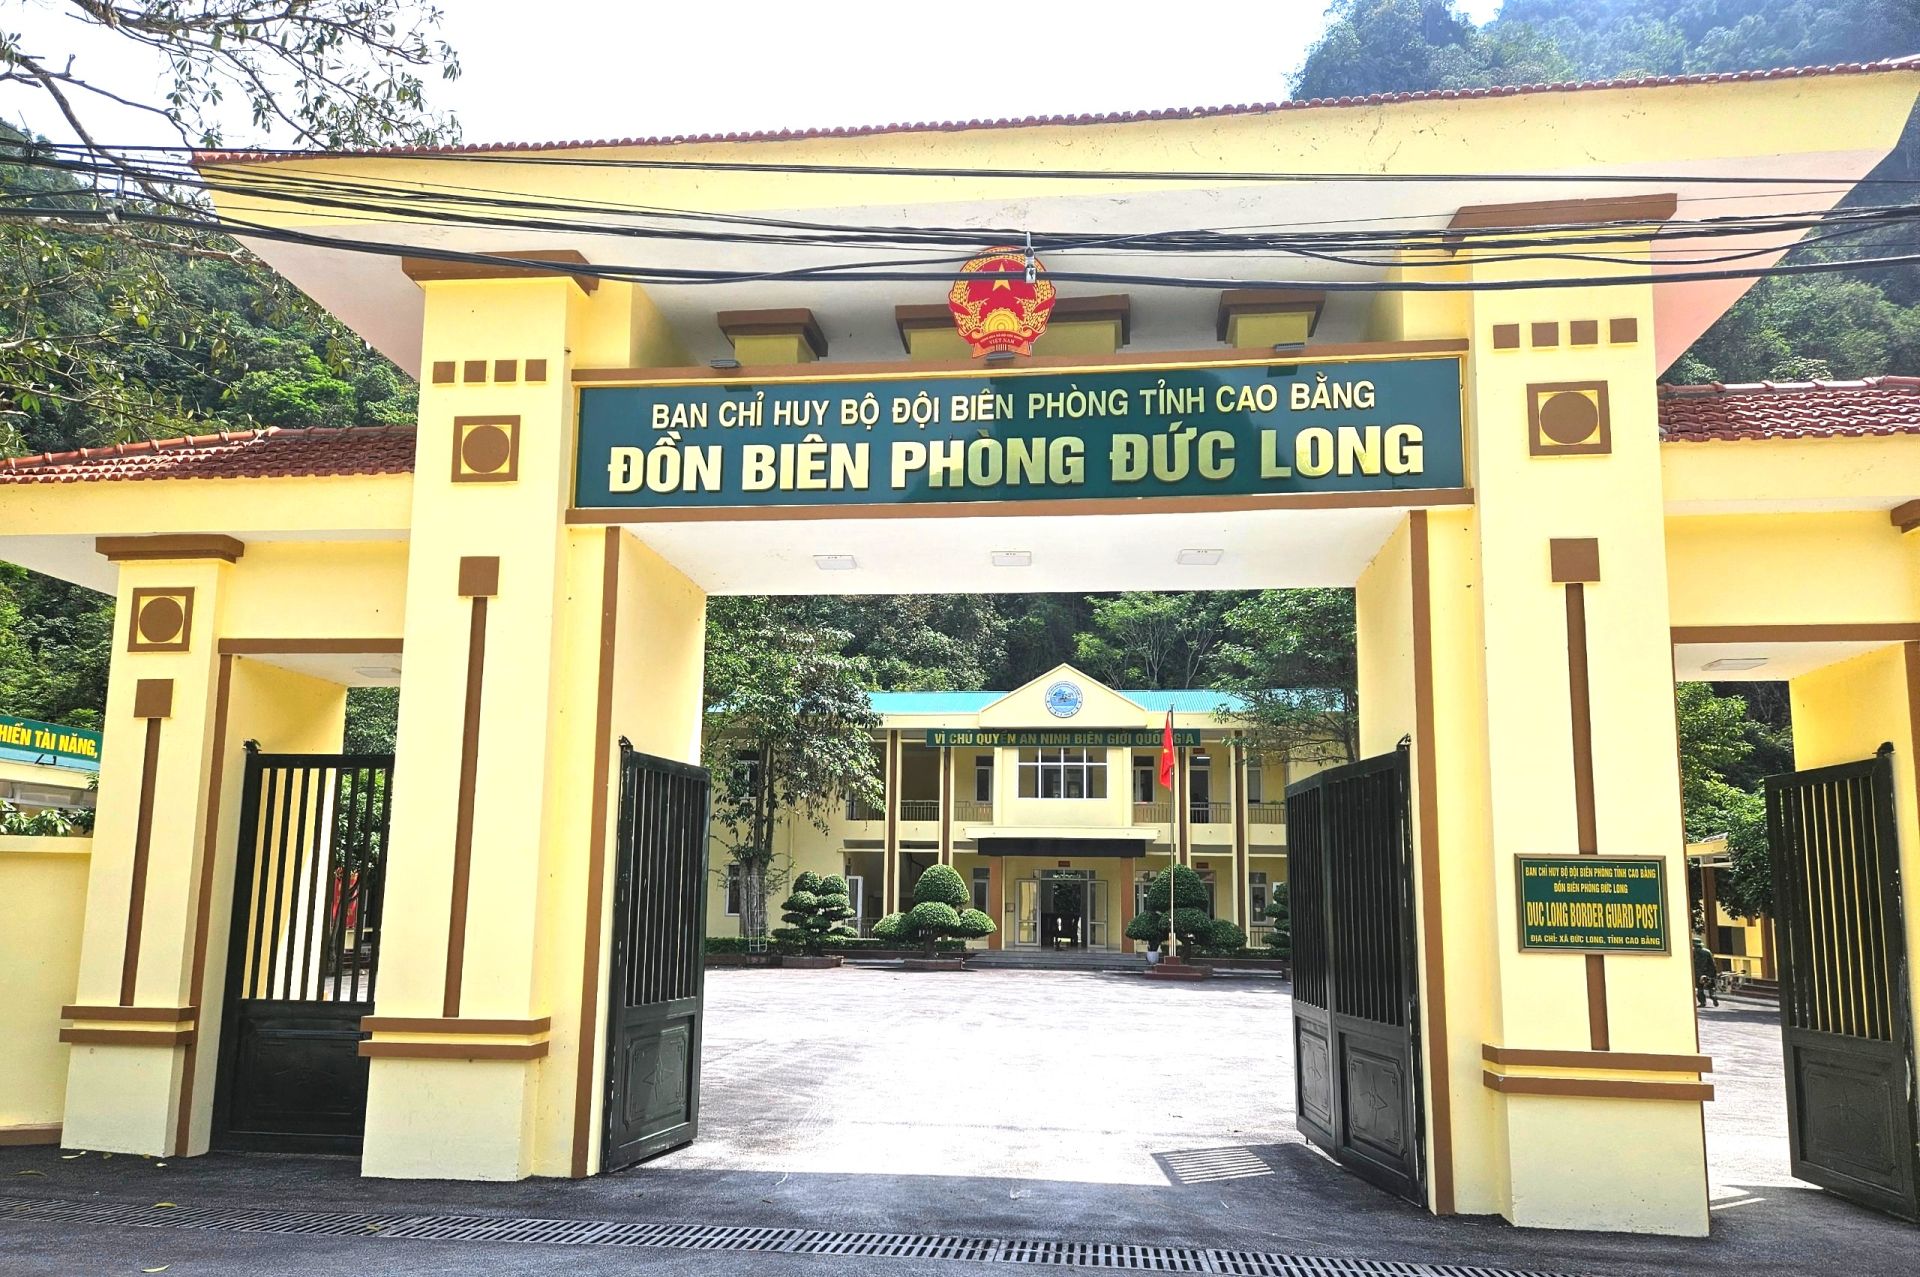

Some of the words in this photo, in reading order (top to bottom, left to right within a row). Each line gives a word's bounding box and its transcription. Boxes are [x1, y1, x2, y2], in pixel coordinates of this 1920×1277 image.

[652, 403, 708, 430] BAN
[719, 391, 764, 428] CHỈ
[774, 400, 830, 427] HUY
[841, 392, 880, 431] BỘ
[892, 391, 940, 429] ĐỘI
[951, 388, 1014, 423] BIÊN
[1028, 383, 1129, 419] PHÒNG
[1140, 379, 1206, 415] TỈNH
[1215, 383, 1278, 413] CAO
[1290, 371, 1376, 412] BẰNG
[608, 431, 722, 494] ĐỒN
[741, 433, 870, 492] BIÊN
[891, 429, 1085, 490] PHÒNG
[1109, 421, 1236, 482] ĐỨC
[1260, 423, 1425, 480] LONG
[35, 727, 56, 750] TÀI
[59, 733, 98, 759] NĂNG,
[934, 730, 946, 745] VÌ
[949, 729, 973, 745] CHỦ
[1020, 732, 1037, 745] AN
[1040, 732, 1071, 746] NINH
[1074, 729, 1102, 746] BIÊN
[1107, 729, 1132, 746] GIỚI
[1525, 867, 1537, 877] BAN
[1538, 864, 1548, 877] CHỈ
[1548, 867, 1559, 877] HUY
[1580, 866, 1593, 877] BIÊN
[1594, 866, 1613, 878] PHÒNG
[1627, 868, 1639, 879] CAO
[1566, 881, 1580, 893] BIÊN
[1613, 883, 1629, 894] LONG
[1527, 902, 1544, 927] DUC
[1546, 902, 1569, 927] LONG
[1569, 903, 1604, 928] BORDER
[1605, 904, 1634, 929] GUARD
[1636, 904, 1658, 929] POST
[1625, 936, 1639, 945] CAO
